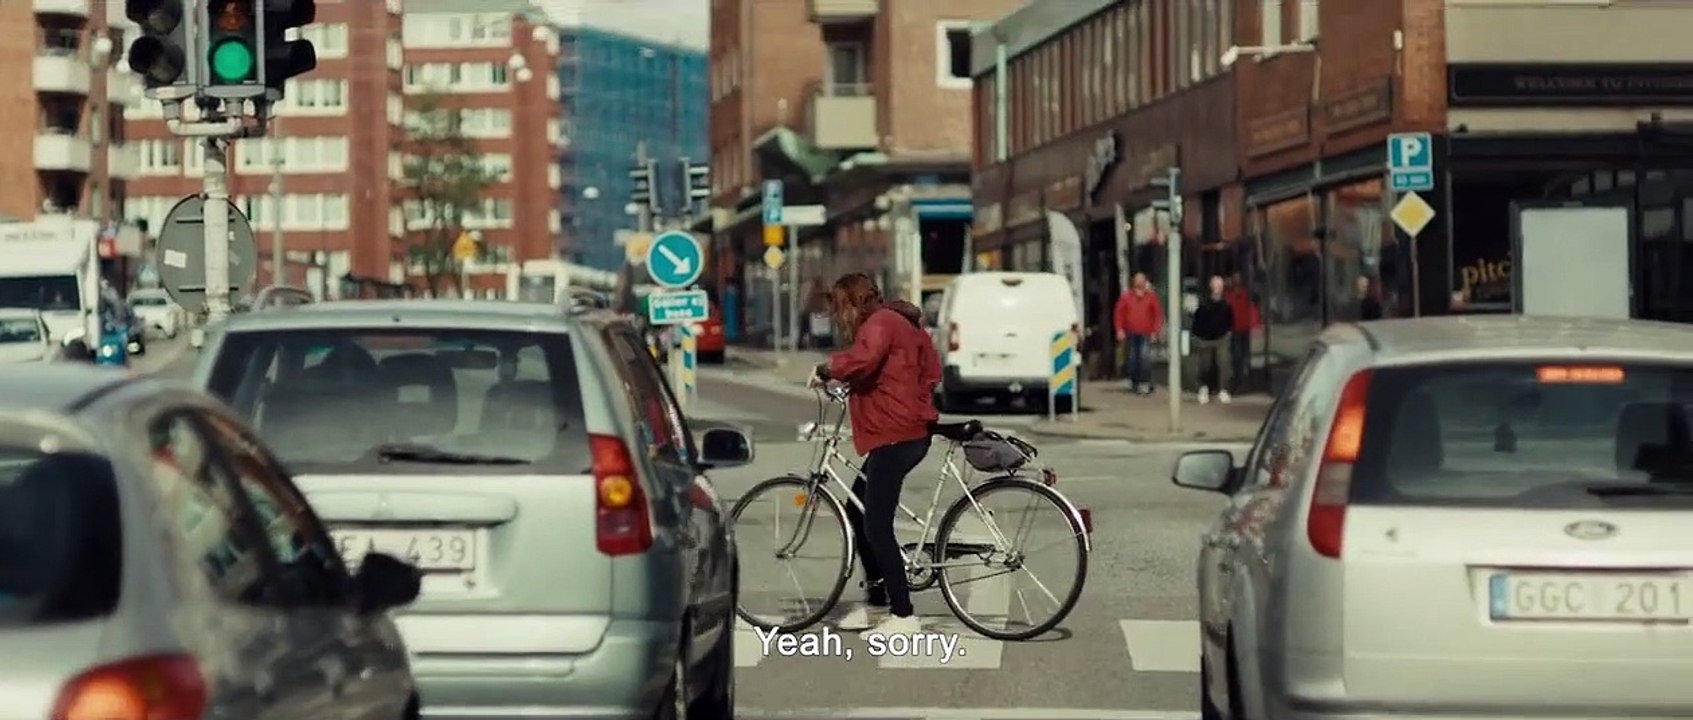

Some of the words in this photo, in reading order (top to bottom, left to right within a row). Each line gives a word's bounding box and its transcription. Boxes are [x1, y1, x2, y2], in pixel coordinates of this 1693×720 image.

[1401, 136, 1422, 167] P
[1461, 258, 1511, 289] pitc
[406, 535, 466, 563] 439
[1515, 581, 1585, 613] GGC
[1615, 582, 1681, 614] 201
